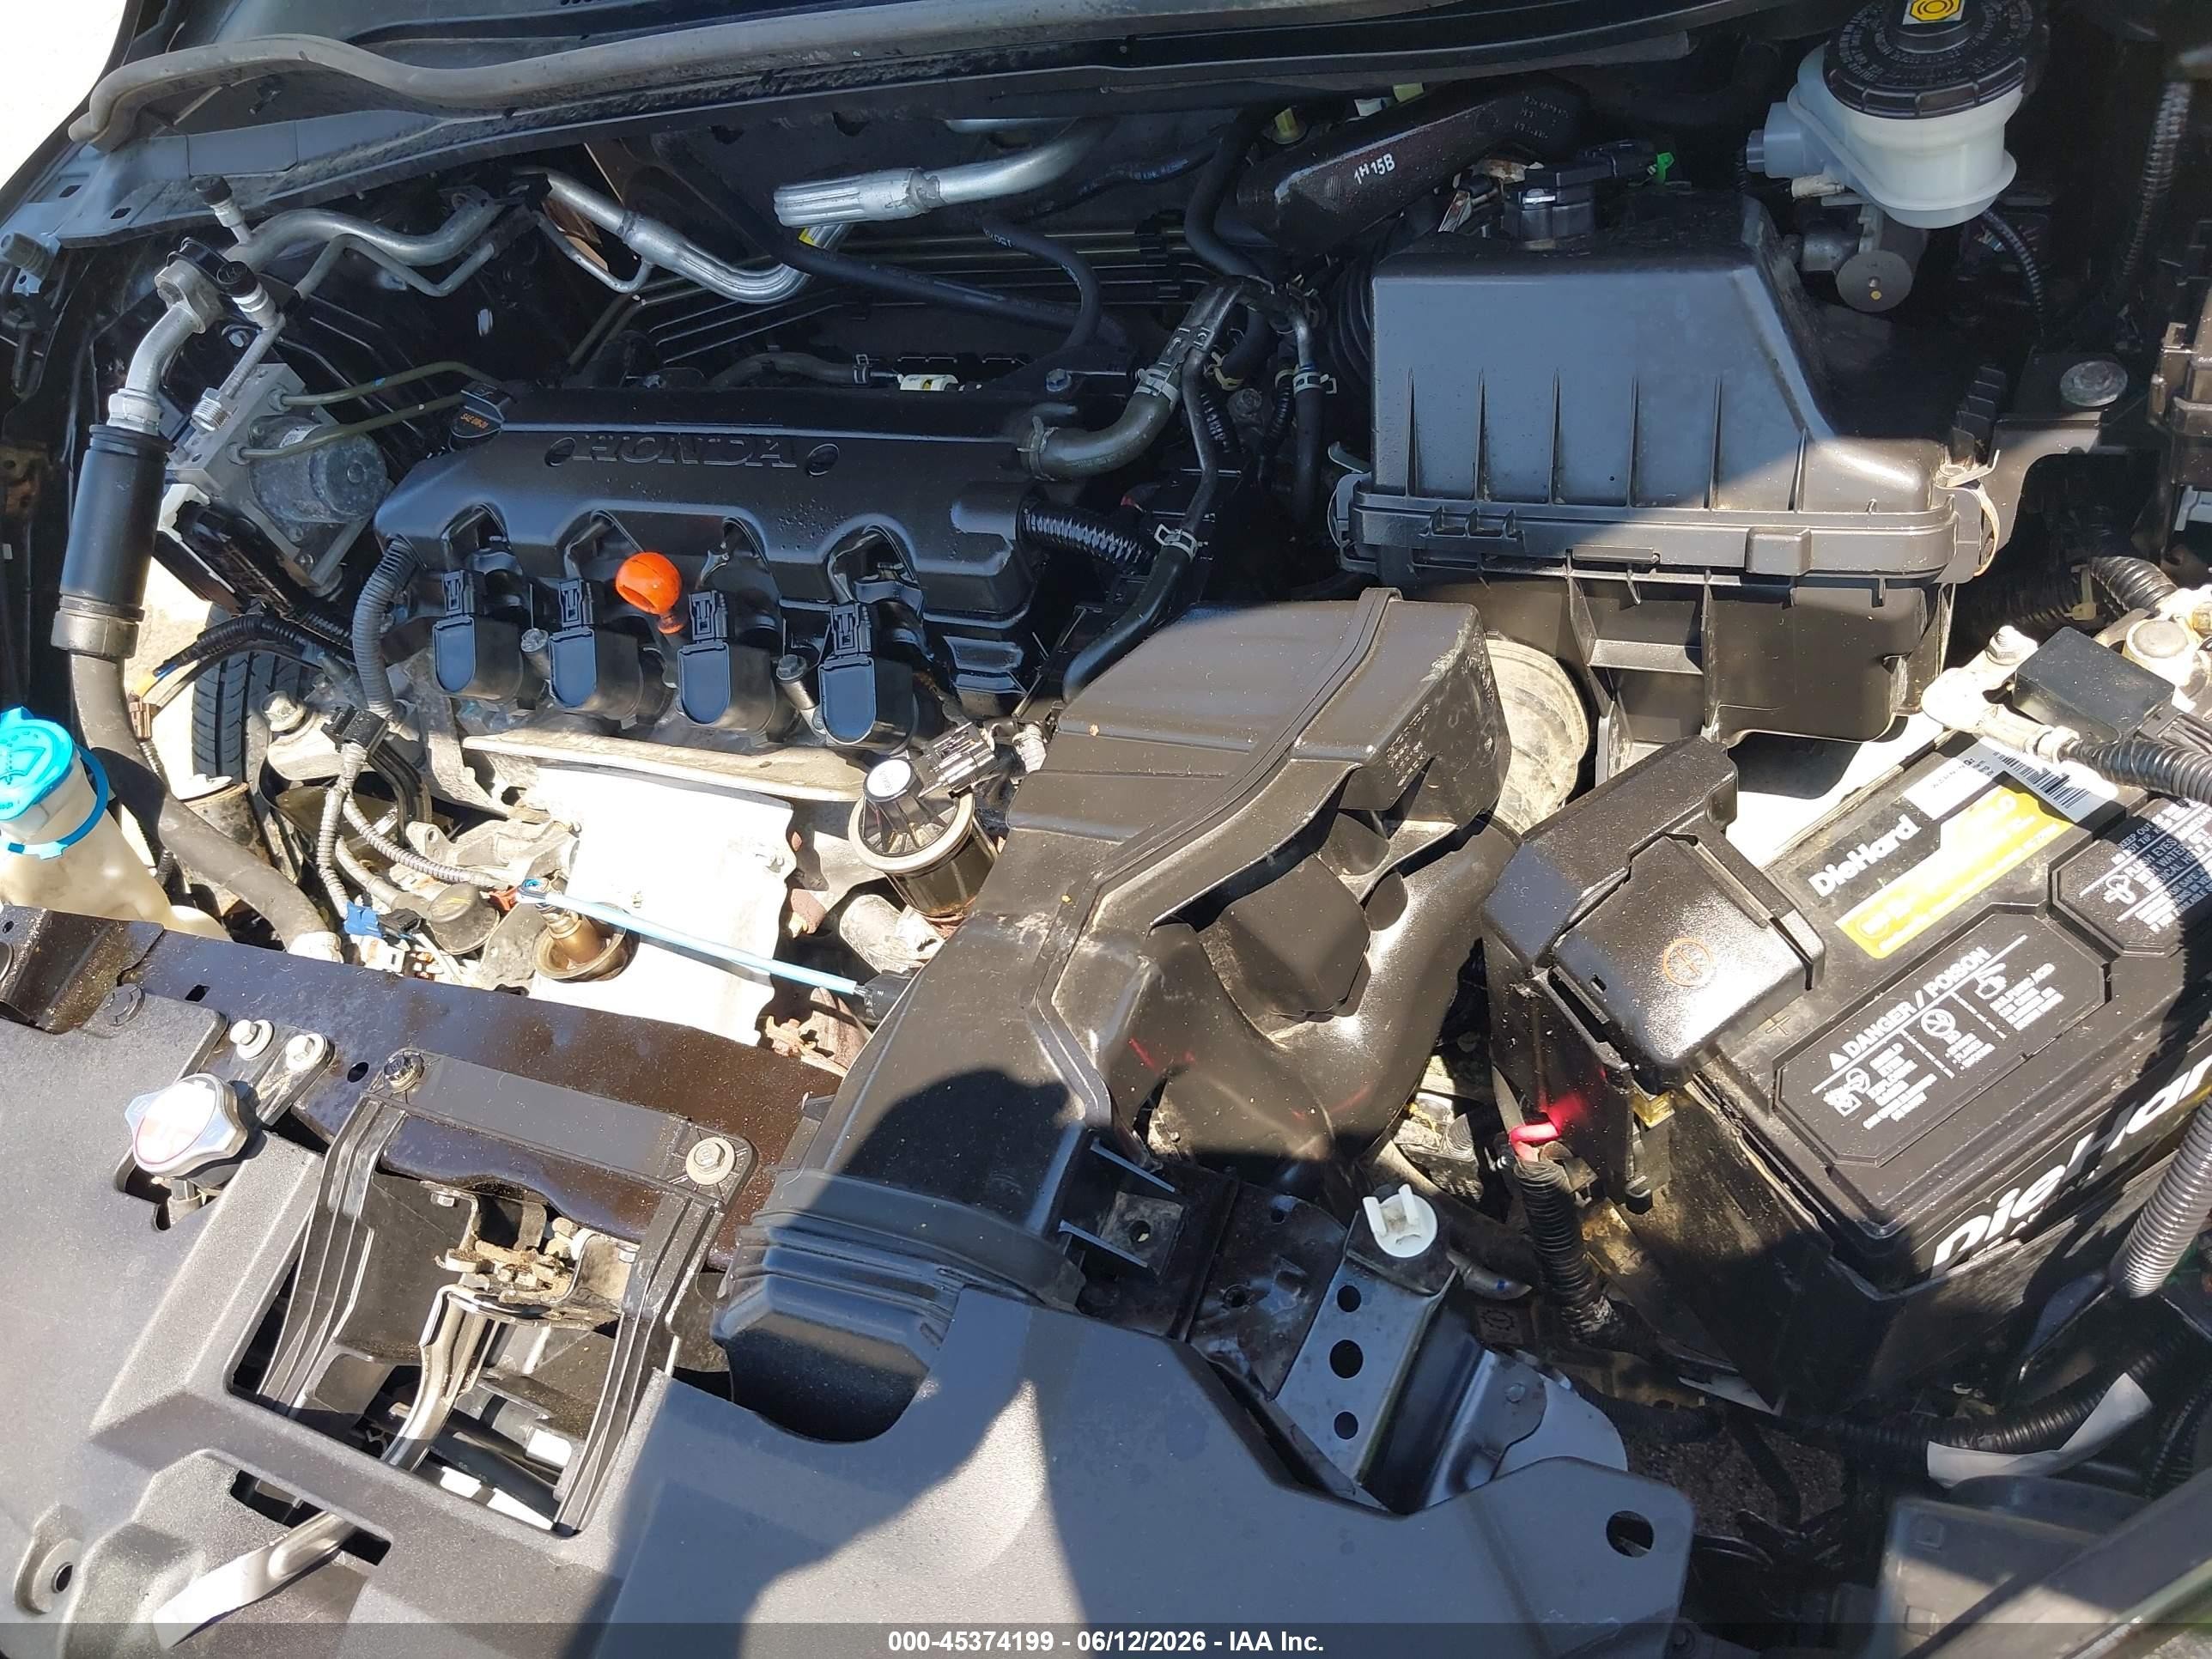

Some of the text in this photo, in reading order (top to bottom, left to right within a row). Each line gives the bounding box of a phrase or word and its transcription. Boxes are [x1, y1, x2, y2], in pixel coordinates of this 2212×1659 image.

[572, 434, 798, 468] HONDA
[2117, 834, 2136, 848] KEEP
[2136, 823, 2153, 836] OUT
[2123, 842, 2140, 857] NOT
[2138, 834, 2154, 846] TIP.
[1808, 814, 1920, 897] DieHard
[2124, 854, 2155, 878] FLUSH
[2152, 838, 2177, 857] EYES
[2143, 864, 2184, 892] MEDICAL
[2182, 844, 2206, 865] HELP
[2156, 844, 2193, 866] WATER.
[2179, 872, 2199, 888] SAFE
[1842, 1000, 1917, 1059] DANGER
[1923, 946, 1992, 998] POISON
